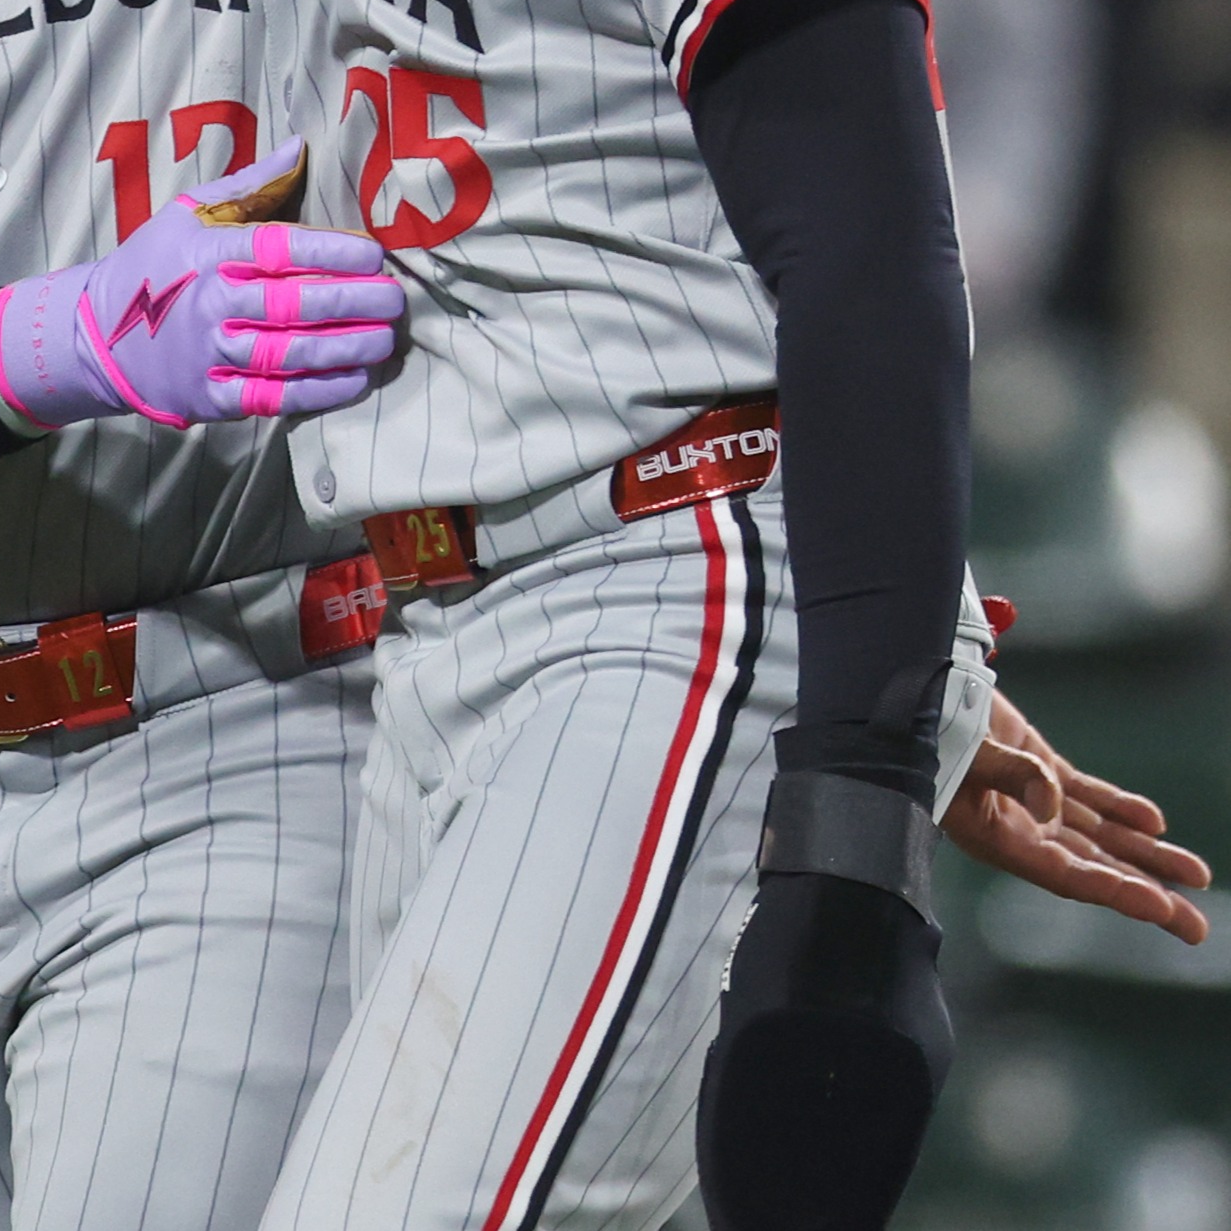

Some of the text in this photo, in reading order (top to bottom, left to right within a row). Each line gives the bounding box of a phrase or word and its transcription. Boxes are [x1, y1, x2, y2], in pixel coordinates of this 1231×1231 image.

[341, 66, 493, 250] 25
[636, 427, 780, 482] BUXTON
[407, 509, 451, 563] 25
[58, 649, 113, 702] 12
